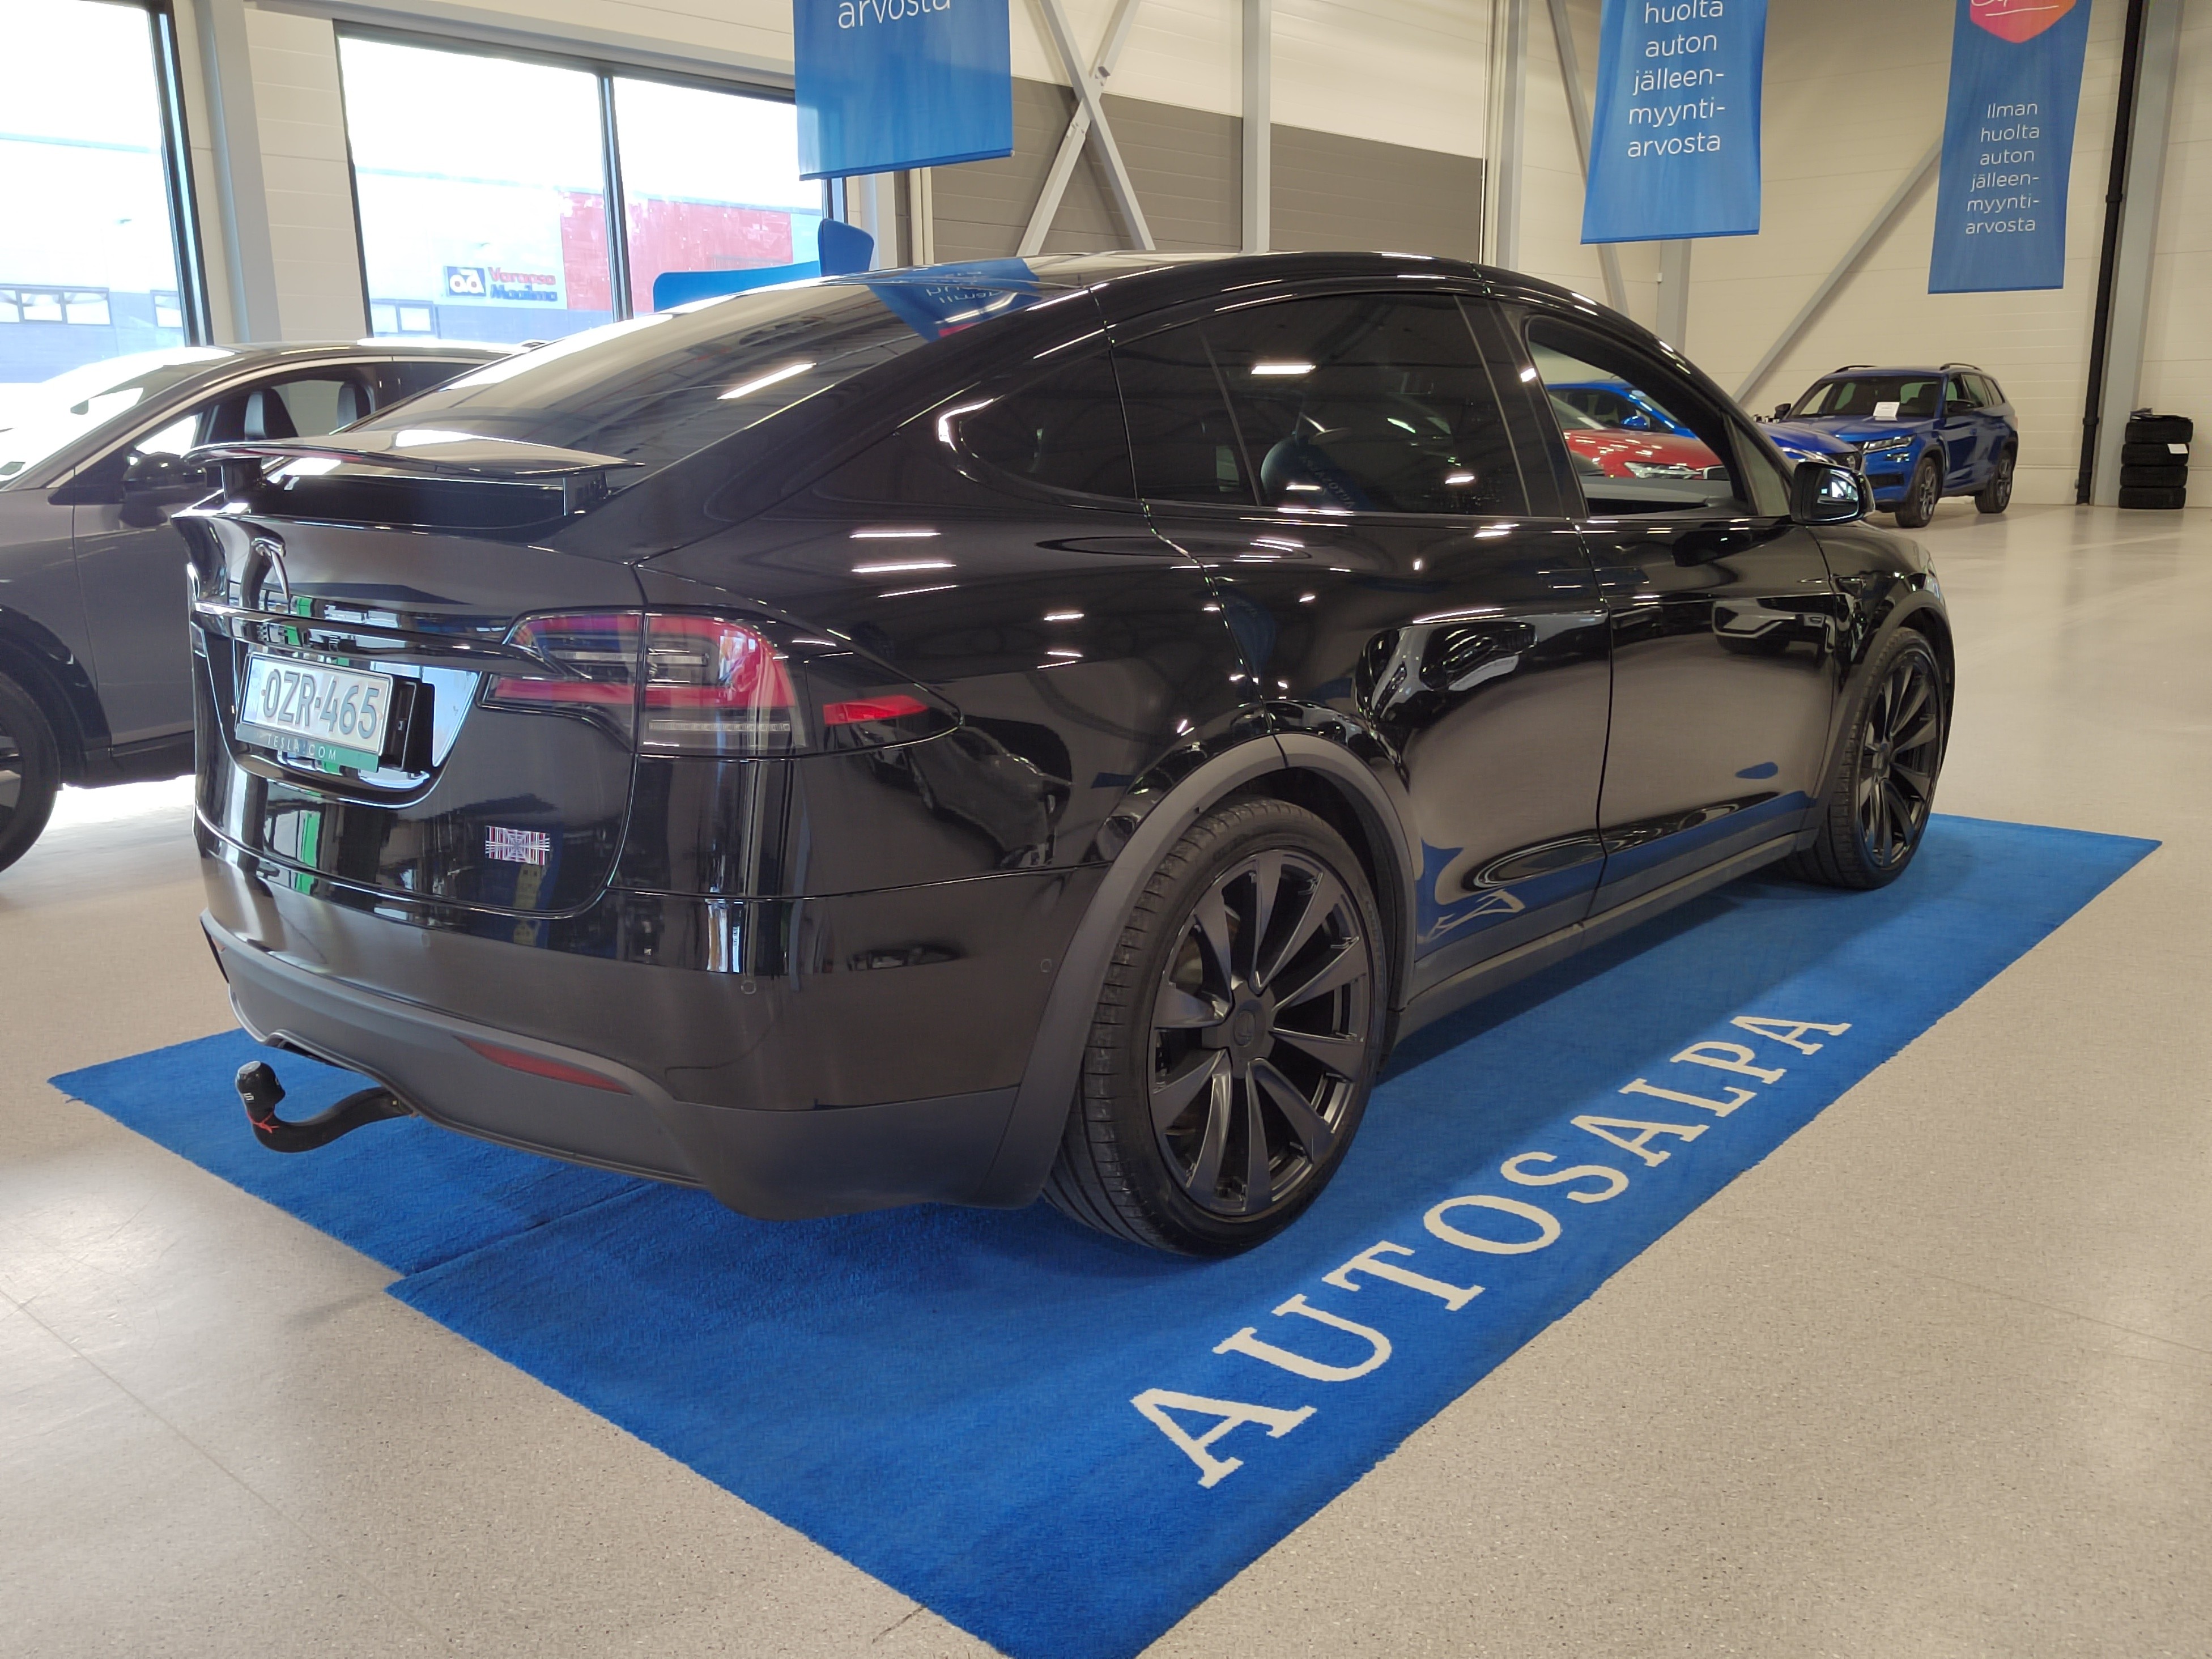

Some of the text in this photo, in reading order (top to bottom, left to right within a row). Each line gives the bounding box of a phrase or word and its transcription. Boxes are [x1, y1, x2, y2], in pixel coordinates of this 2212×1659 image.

[1645, 0, 1724, 24] huolta
[1645, 34, 1717, 57] auton
[1632, 67, 1724, 96] jälleen-
[1628, 96, 1725, 127] myynti-
[1986, 103, 2038, 118] Ilman
[1627, 132, 1721, 158] arvosta
[1980, 125, 2040, 143] huolta
[1980, 150, 2035, 165] auton
[1970, 173, 2039, 192] jälleen-
[1967, 193, 2040, 214] myynti-
[1966, 218, 2036, 234] arvosta
[263, 668, 381, 739] OZR-465
[267, 734, 337, 760] TESLA.COM
[1131, 1014, 1852, 1490] AUTOSALPA
